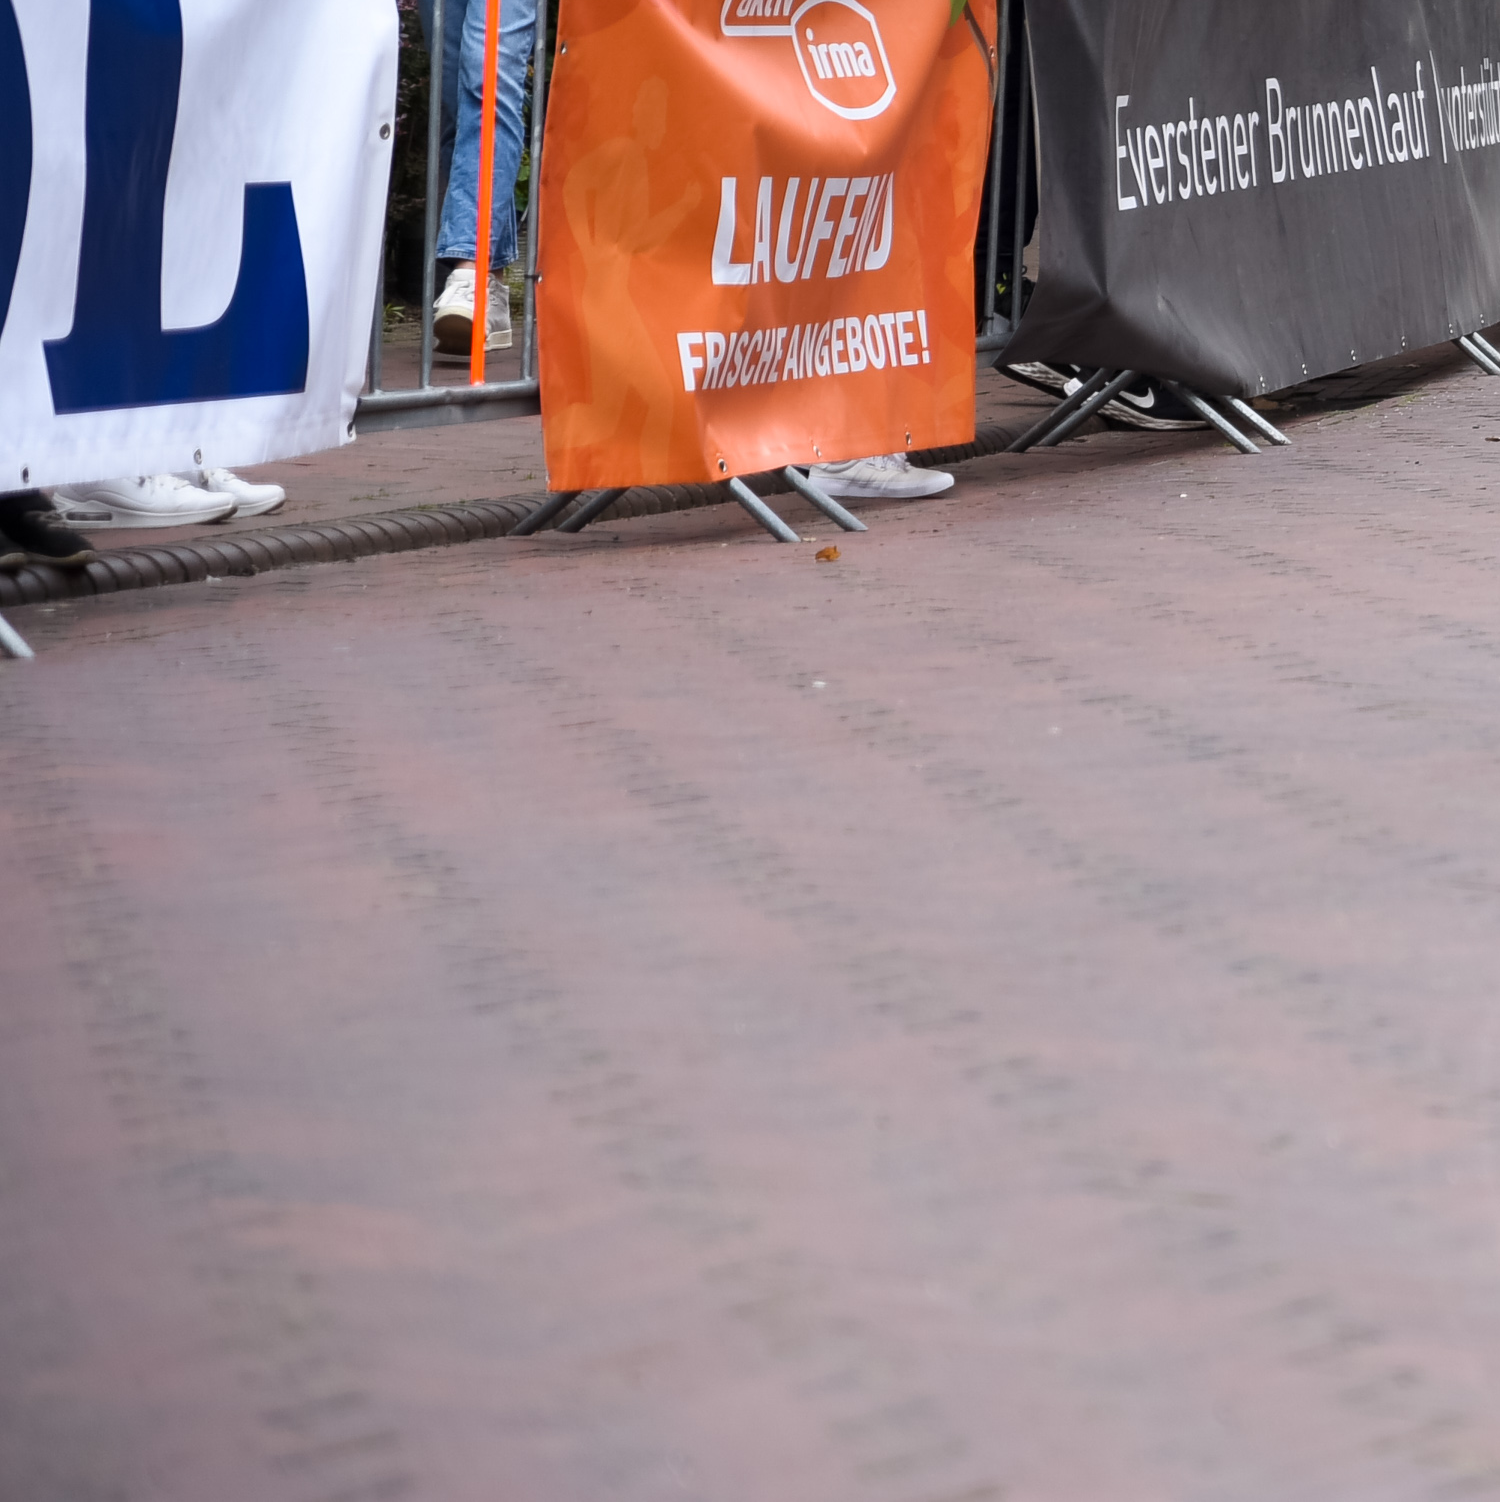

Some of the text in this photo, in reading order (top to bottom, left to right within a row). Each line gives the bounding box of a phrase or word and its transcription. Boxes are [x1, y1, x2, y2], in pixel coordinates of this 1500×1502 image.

[805, 27, 877, 80] irma
[1114, 94, 1260, 212] Everstener
[1265, 60, 1430, 185] Brunnenlauf
[676, 309, 932, 392] FRISCHE ANGEBOTE!
